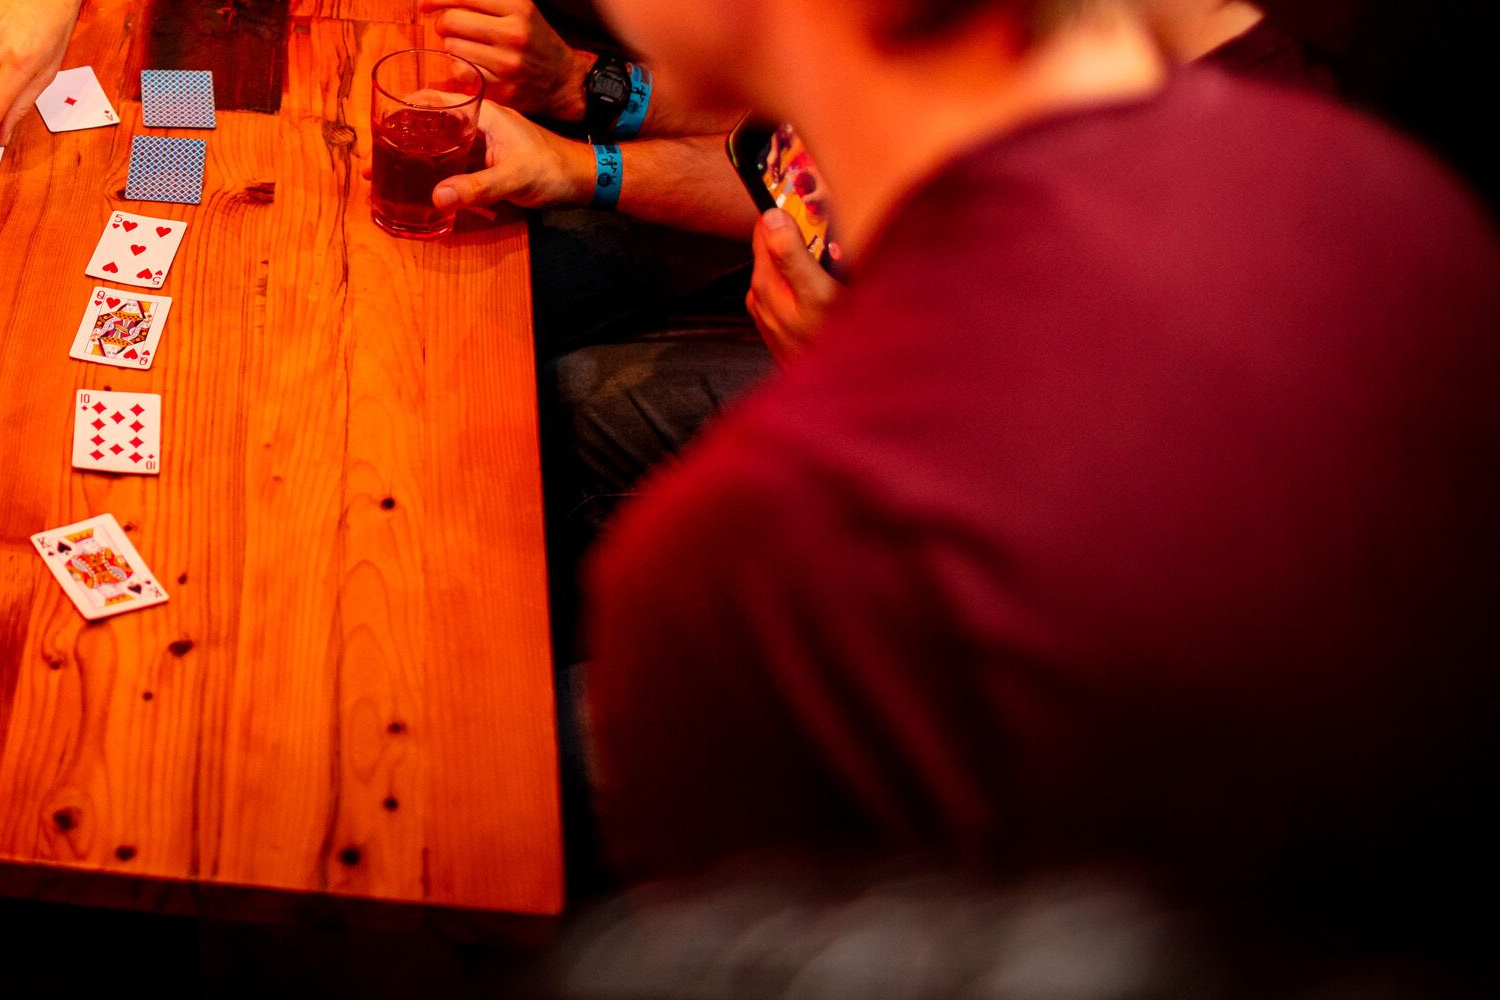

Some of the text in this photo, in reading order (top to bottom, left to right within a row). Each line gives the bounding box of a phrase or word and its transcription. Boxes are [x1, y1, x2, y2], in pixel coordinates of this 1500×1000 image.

[113, 213, 123, 223] 5
[152, 276, 163, 286] 5
[96, 290, 106, 300] Q
[138, 356, 148, 366] Q
[80, 393, 90, 404] 10
[145, 460, 156, 470] 10
